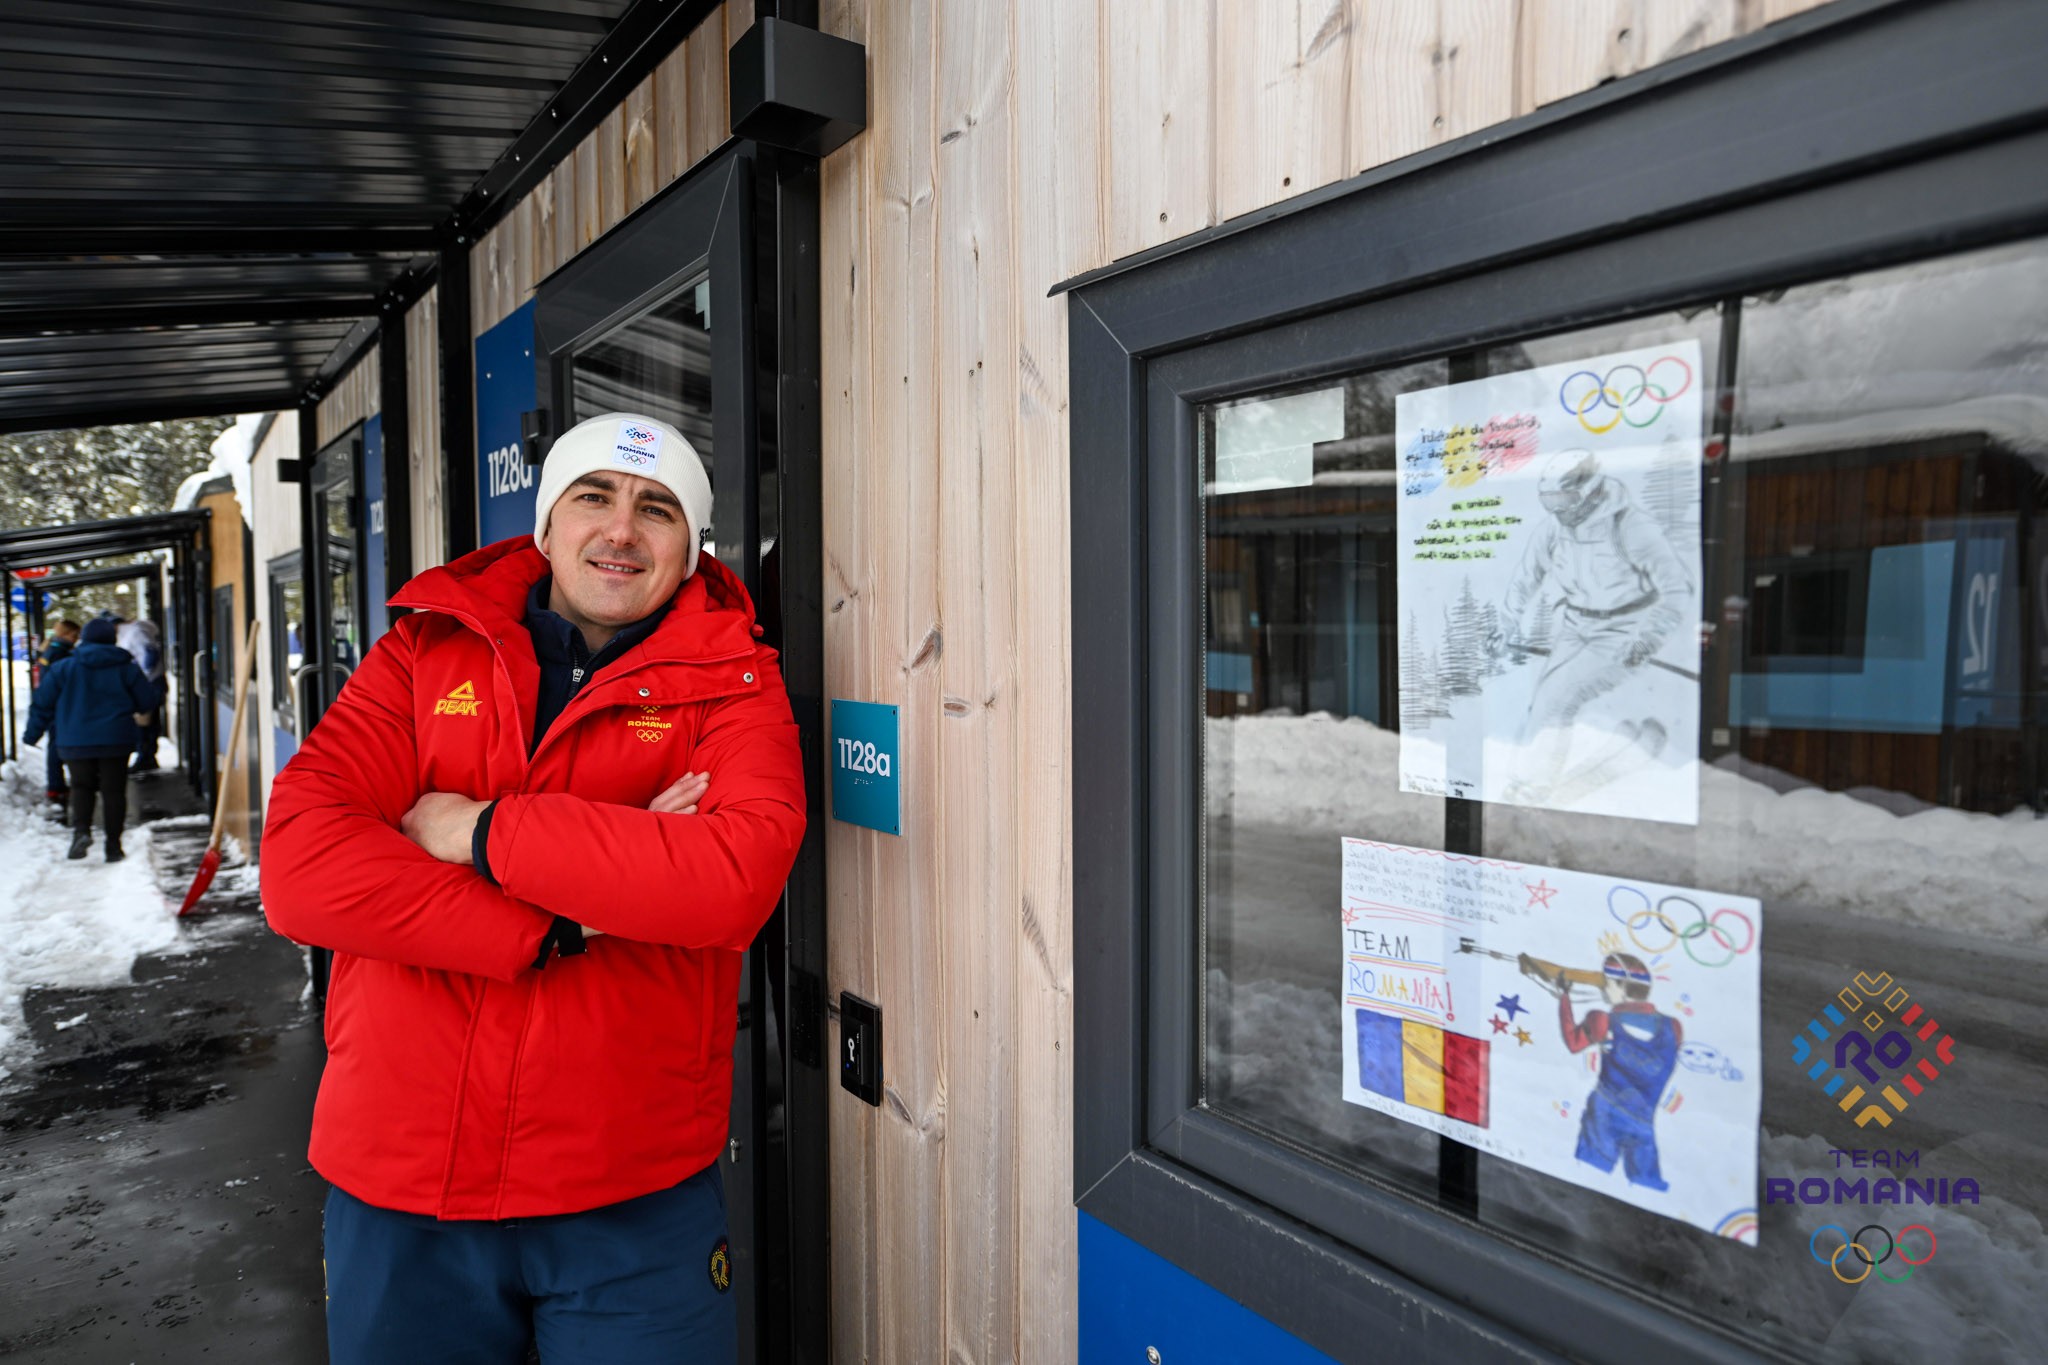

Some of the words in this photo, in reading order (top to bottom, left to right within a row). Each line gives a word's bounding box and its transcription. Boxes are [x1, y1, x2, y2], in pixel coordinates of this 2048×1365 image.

[617, 445, 655, 458] ROMANIA
[488, 443, 533, 498] 1128a
[371, 500, 384, 535] 112
[433, 698, 484, 717] PEAK
[627, 720, 673, 729] ROMANIA
[838, 738, 890, 777] 1128a
[1347, 928, 1411, 960] TEAM
